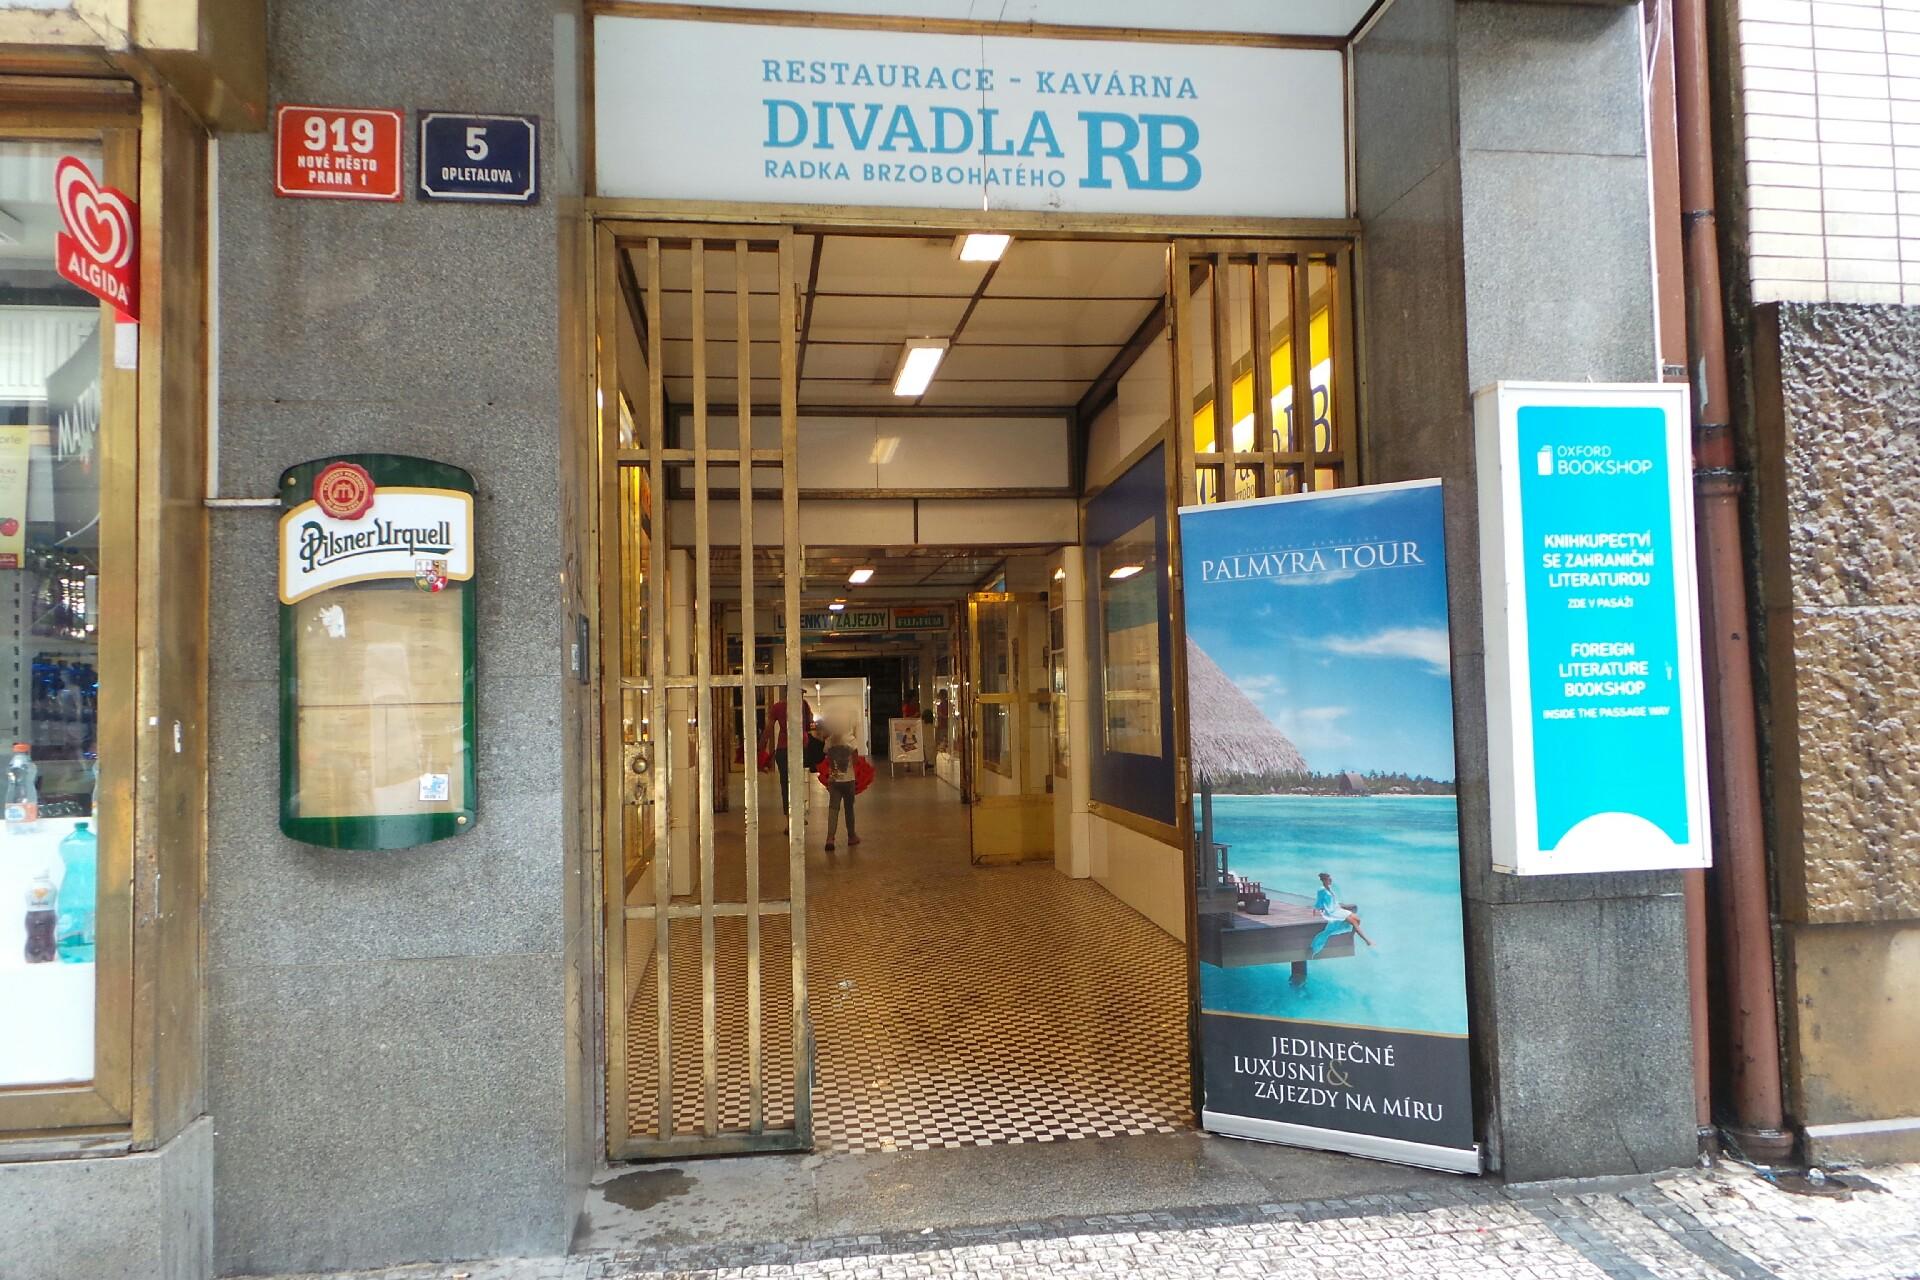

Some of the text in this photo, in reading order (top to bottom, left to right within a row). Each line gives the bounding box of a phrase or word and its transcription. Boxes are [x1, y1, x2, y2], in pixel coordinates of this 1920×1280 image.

[762, 59, 994, 91] RESTAURACE
[1036, 70, 1198, 99] KAVÁRNA
[303, 116, 375, 154] 919
[465, 127, 489, 161] 5
[762, 98, 1202, 191] DIVADLA RB
[297, 153, 378, 172] NOVÉ MĚSTO
[308, 170, 367, 186] PRAHA 1
[442, 167, 513, 183] OPLETALOVA
[764, 159, 1066, 188] RADKA BRZOBOHATÉHO
[68, 251, 128, 306] ALGIDA
[1557, 445, 1612, 457] OXFORD
[1558, 459, 1653, 475] BOOKSHOP
[300, 517, 451, 574] Pilsner Urquell
[1544, 530, 1651, 549] KNIHKUPECTVÍ
[1202, 550, 1326, 581] PALMYRA
[1334, 541, 1424, 569] TOUR
[1543, 549, 1655, 568] SE ZAHRANIČNÍ
[1549, 572, 1650, 588] LITERATUROU
[1567, 598, 1587, 609] ZDE
[1588, 599, 1596, 608] V
[1571, 642, 1635, 658] FOREIGN
[1558, 660, 1649, 678] LITERATURE
[1564, 680, 1647, 698] BOOKSHOP
[1543, 708, 1576, 720] INSIDE
[1577, 707, 1598, 719] THE
[1599, 706, 1647, 718] PASSAGE
[1271, 1036, 1396, 1067] JEDINEČNÉ
[1234, 1056, 1353, 1088] LUXUSNÍ &
[1254, 1080, 1444, 1122] ZÁJEZDY NA MÍRU
